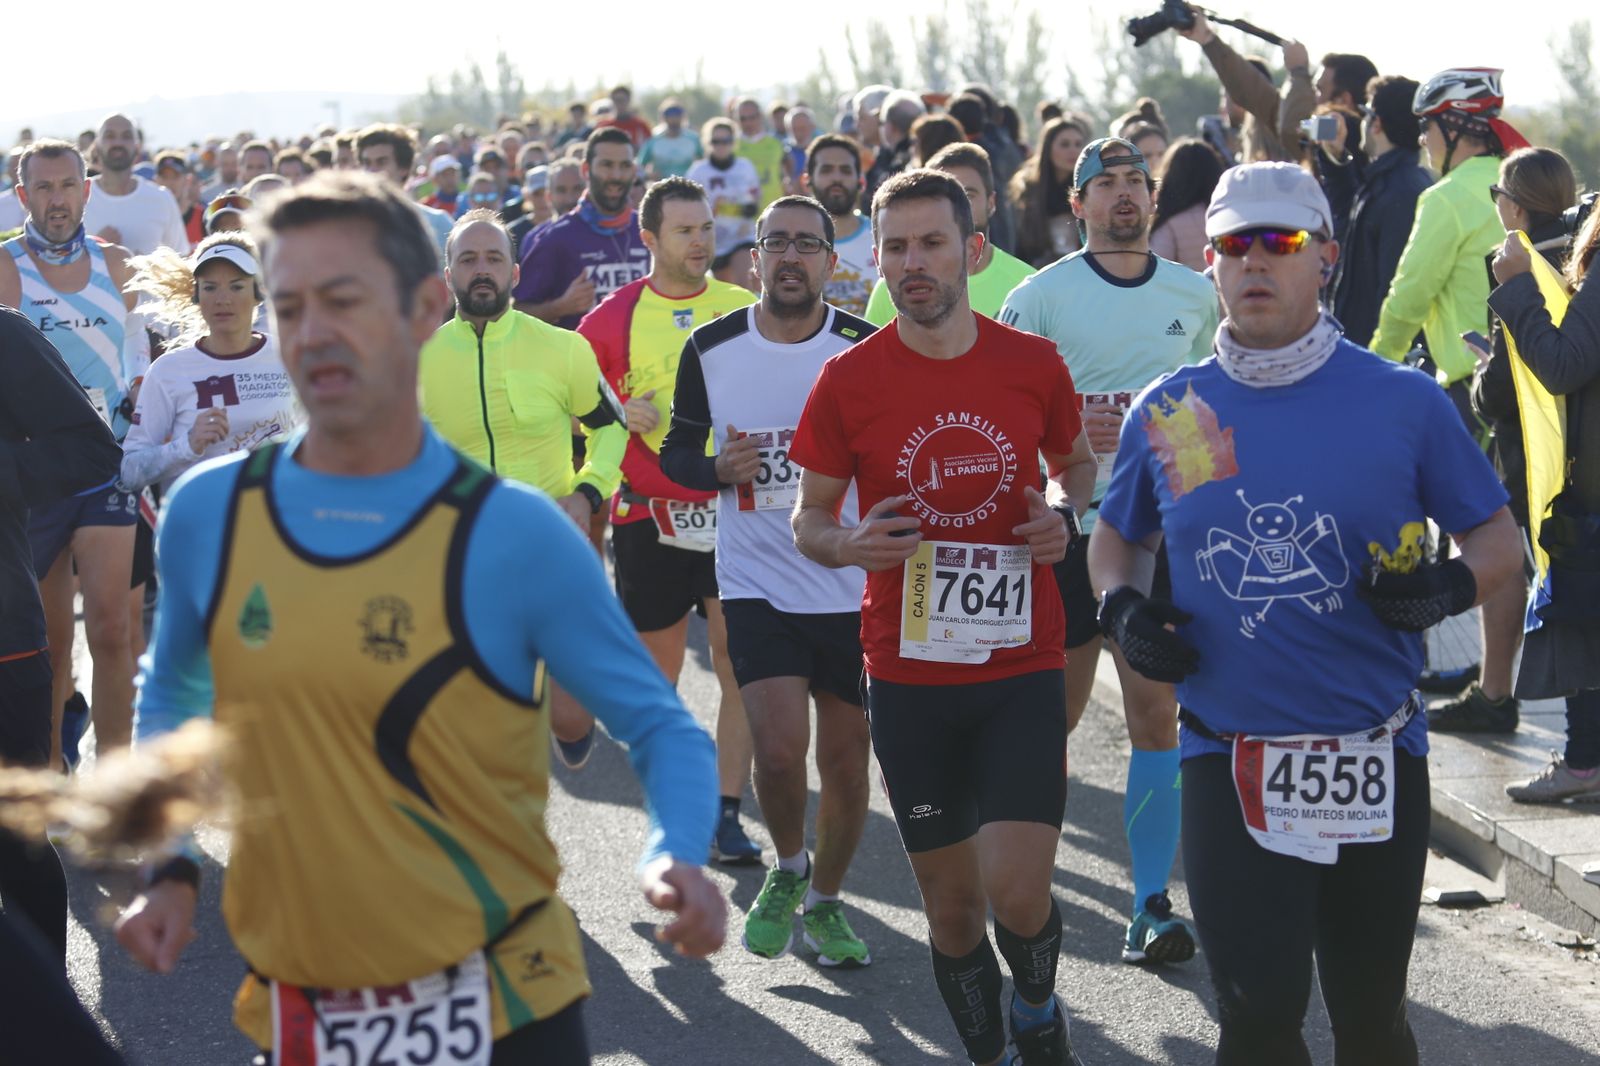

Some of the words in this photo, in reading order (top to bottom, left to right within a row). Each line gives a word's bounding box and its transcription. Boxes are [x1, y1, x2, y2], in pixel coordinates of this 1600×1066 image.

[236, 373, 251, 382] 35
[253, 372, 288, 381] MEDIA
[896, 426, 926, 479] XXXIII
[935, 412, 1017, 493] SANSILVESTRE
[755, 449, 801, 485] 53
[944, 459, 975, 467] Asociación
[944, 468, 956, 477] EL
[958, 463, 998, 475] PARQUE
[905, 491, 997, 528] CORDOBESA
[916, 562, 927, 570] 5
[936, 556, 966, 565] IMDECO
[911, 573, 926, 618] CAJÓN
[936, 570, 1025, 617] 7641
[945, 616, 970, 625] CARLOS
[1266, 753, 1387, 806] 4558
[1264, 806, 1299, 818] PEDRO
[1302, 809, 1345, 820] MATEOS
[1347, 809, 1388, 820] MOLINA
[1318, 831, 1357, 839] Cruzcampo
[325, 997, 482, 1066] 5255
